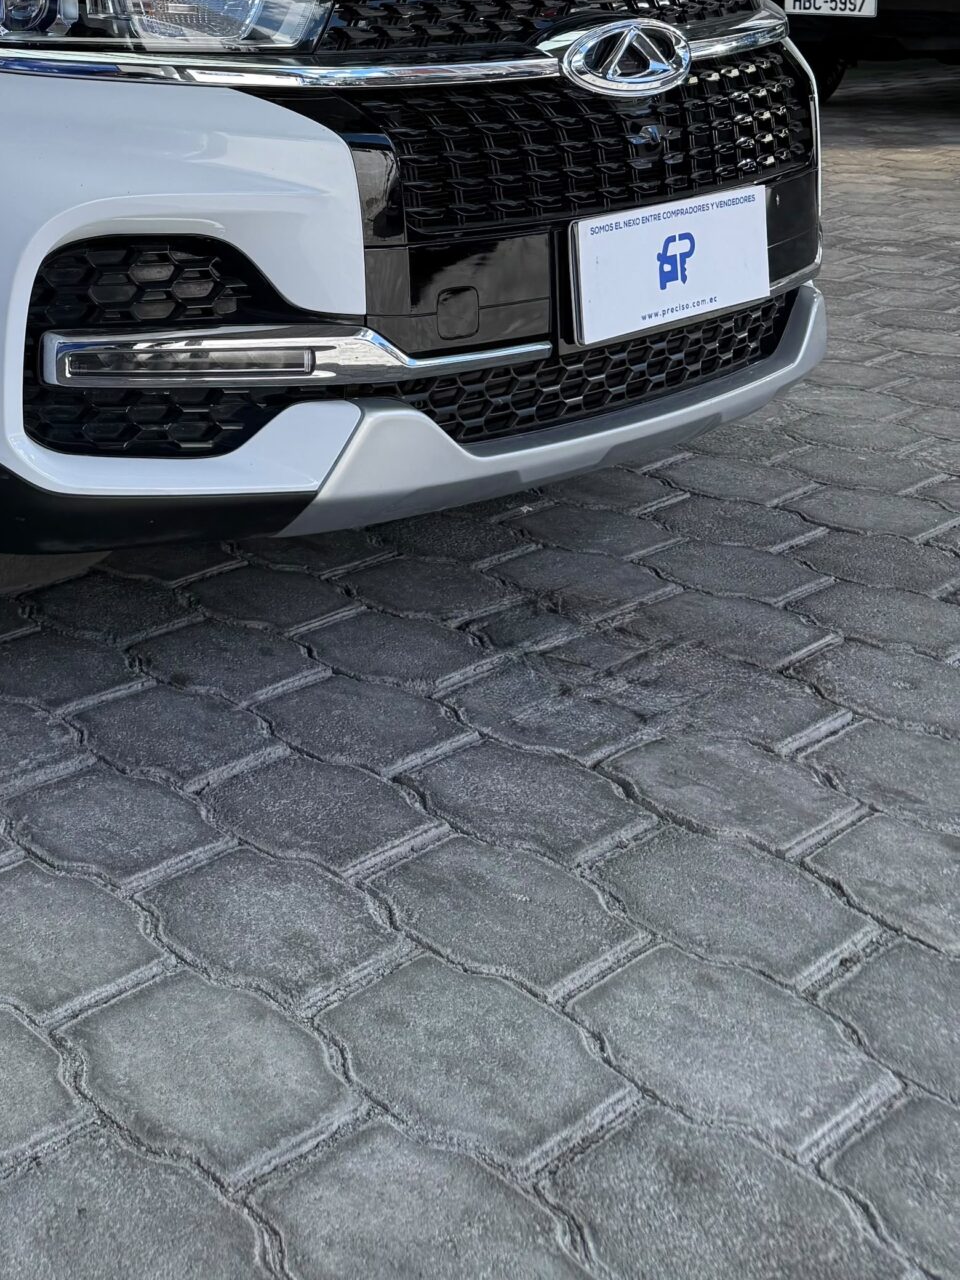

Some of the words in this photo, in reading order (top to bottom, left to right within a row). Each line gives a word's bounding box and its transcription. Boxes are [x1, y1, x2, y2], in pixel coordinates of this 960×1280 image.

[590, 223, 614, 236] SOMOS
[615, 222, 623, 230] EL
[624, 218, 641, 228] NEXO
[641, 213, 661, 224] ENTRE
[662, 203, 710, 220] COMPRADORES
[711, 202, 716, 210] Y
[715, 194, 756, 209] VENDEDORES
[641, 296, 718, 321] www.preciso.com.ec
